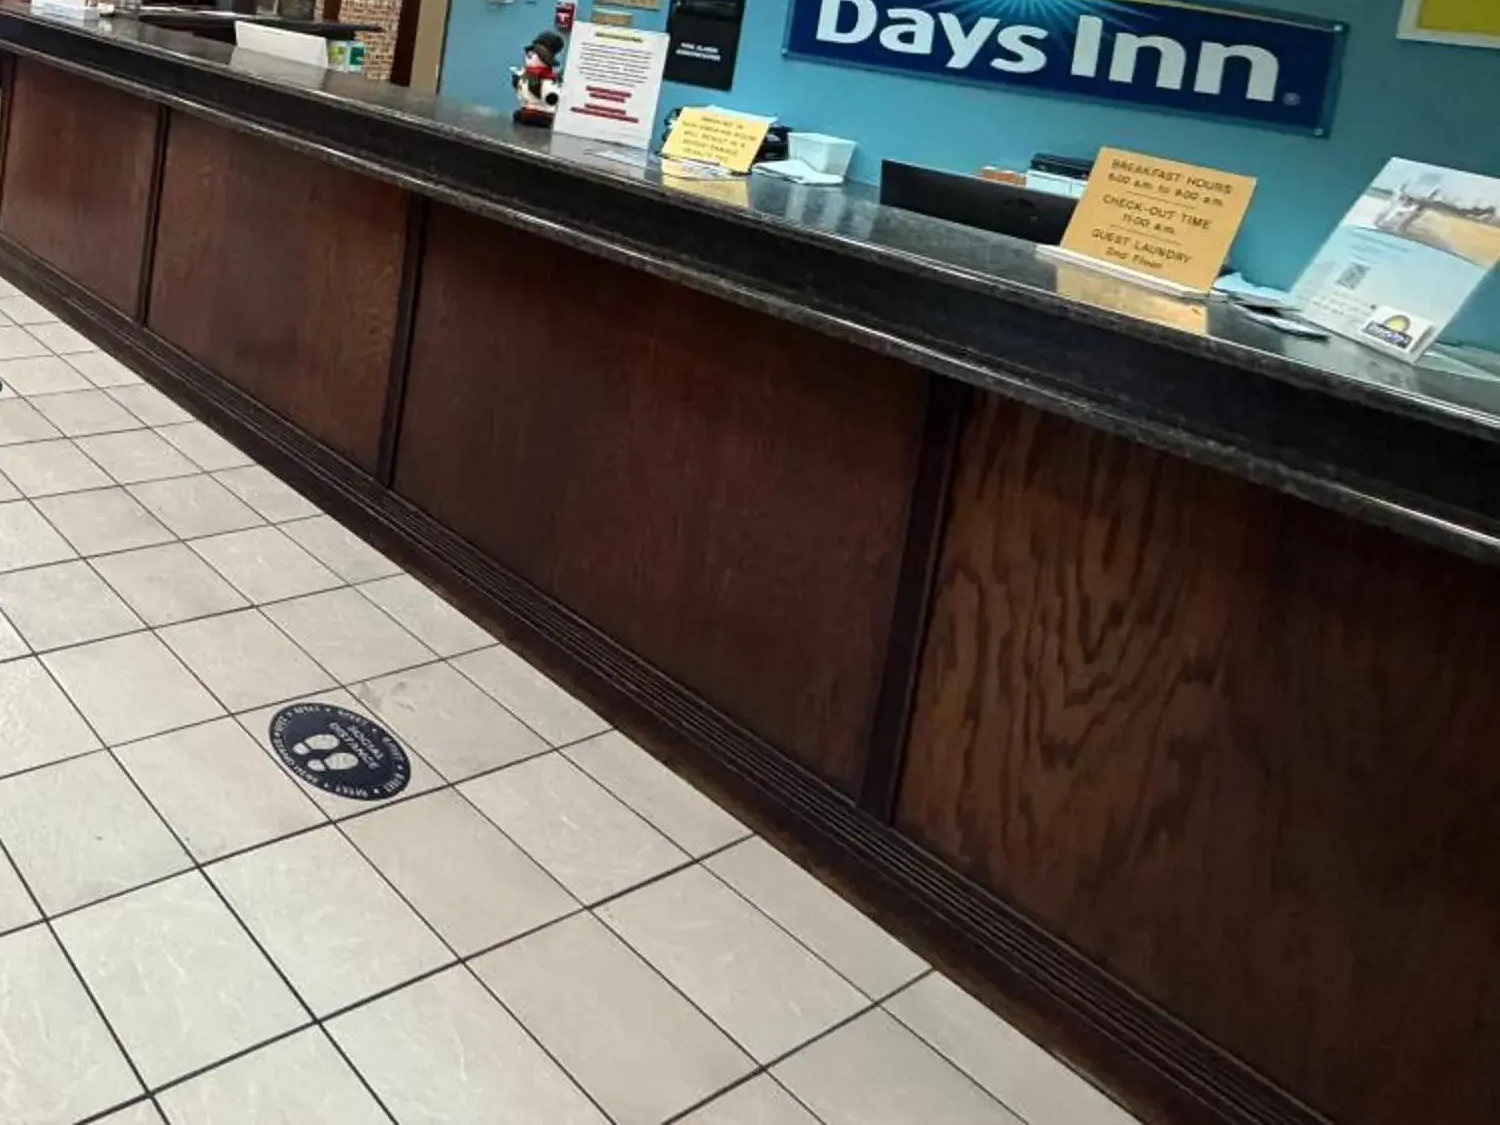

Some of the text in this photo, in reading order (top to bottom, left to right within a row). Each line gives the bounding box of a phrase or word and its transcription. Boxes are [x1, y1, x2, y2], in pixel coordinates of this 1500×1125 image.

[1071, 14, 1280, 102] Inn
[1112, 159, 1233, 195] BREAKFAST HOURS
[1102, 194, 1212, 230] CHECK-OUT TIME
[1091, 228, 1193, 264] GUEST LAUNDRY
[328, 722, 382, 771] DISTANCE
[346, 725, 385, 761] SOCIAL
